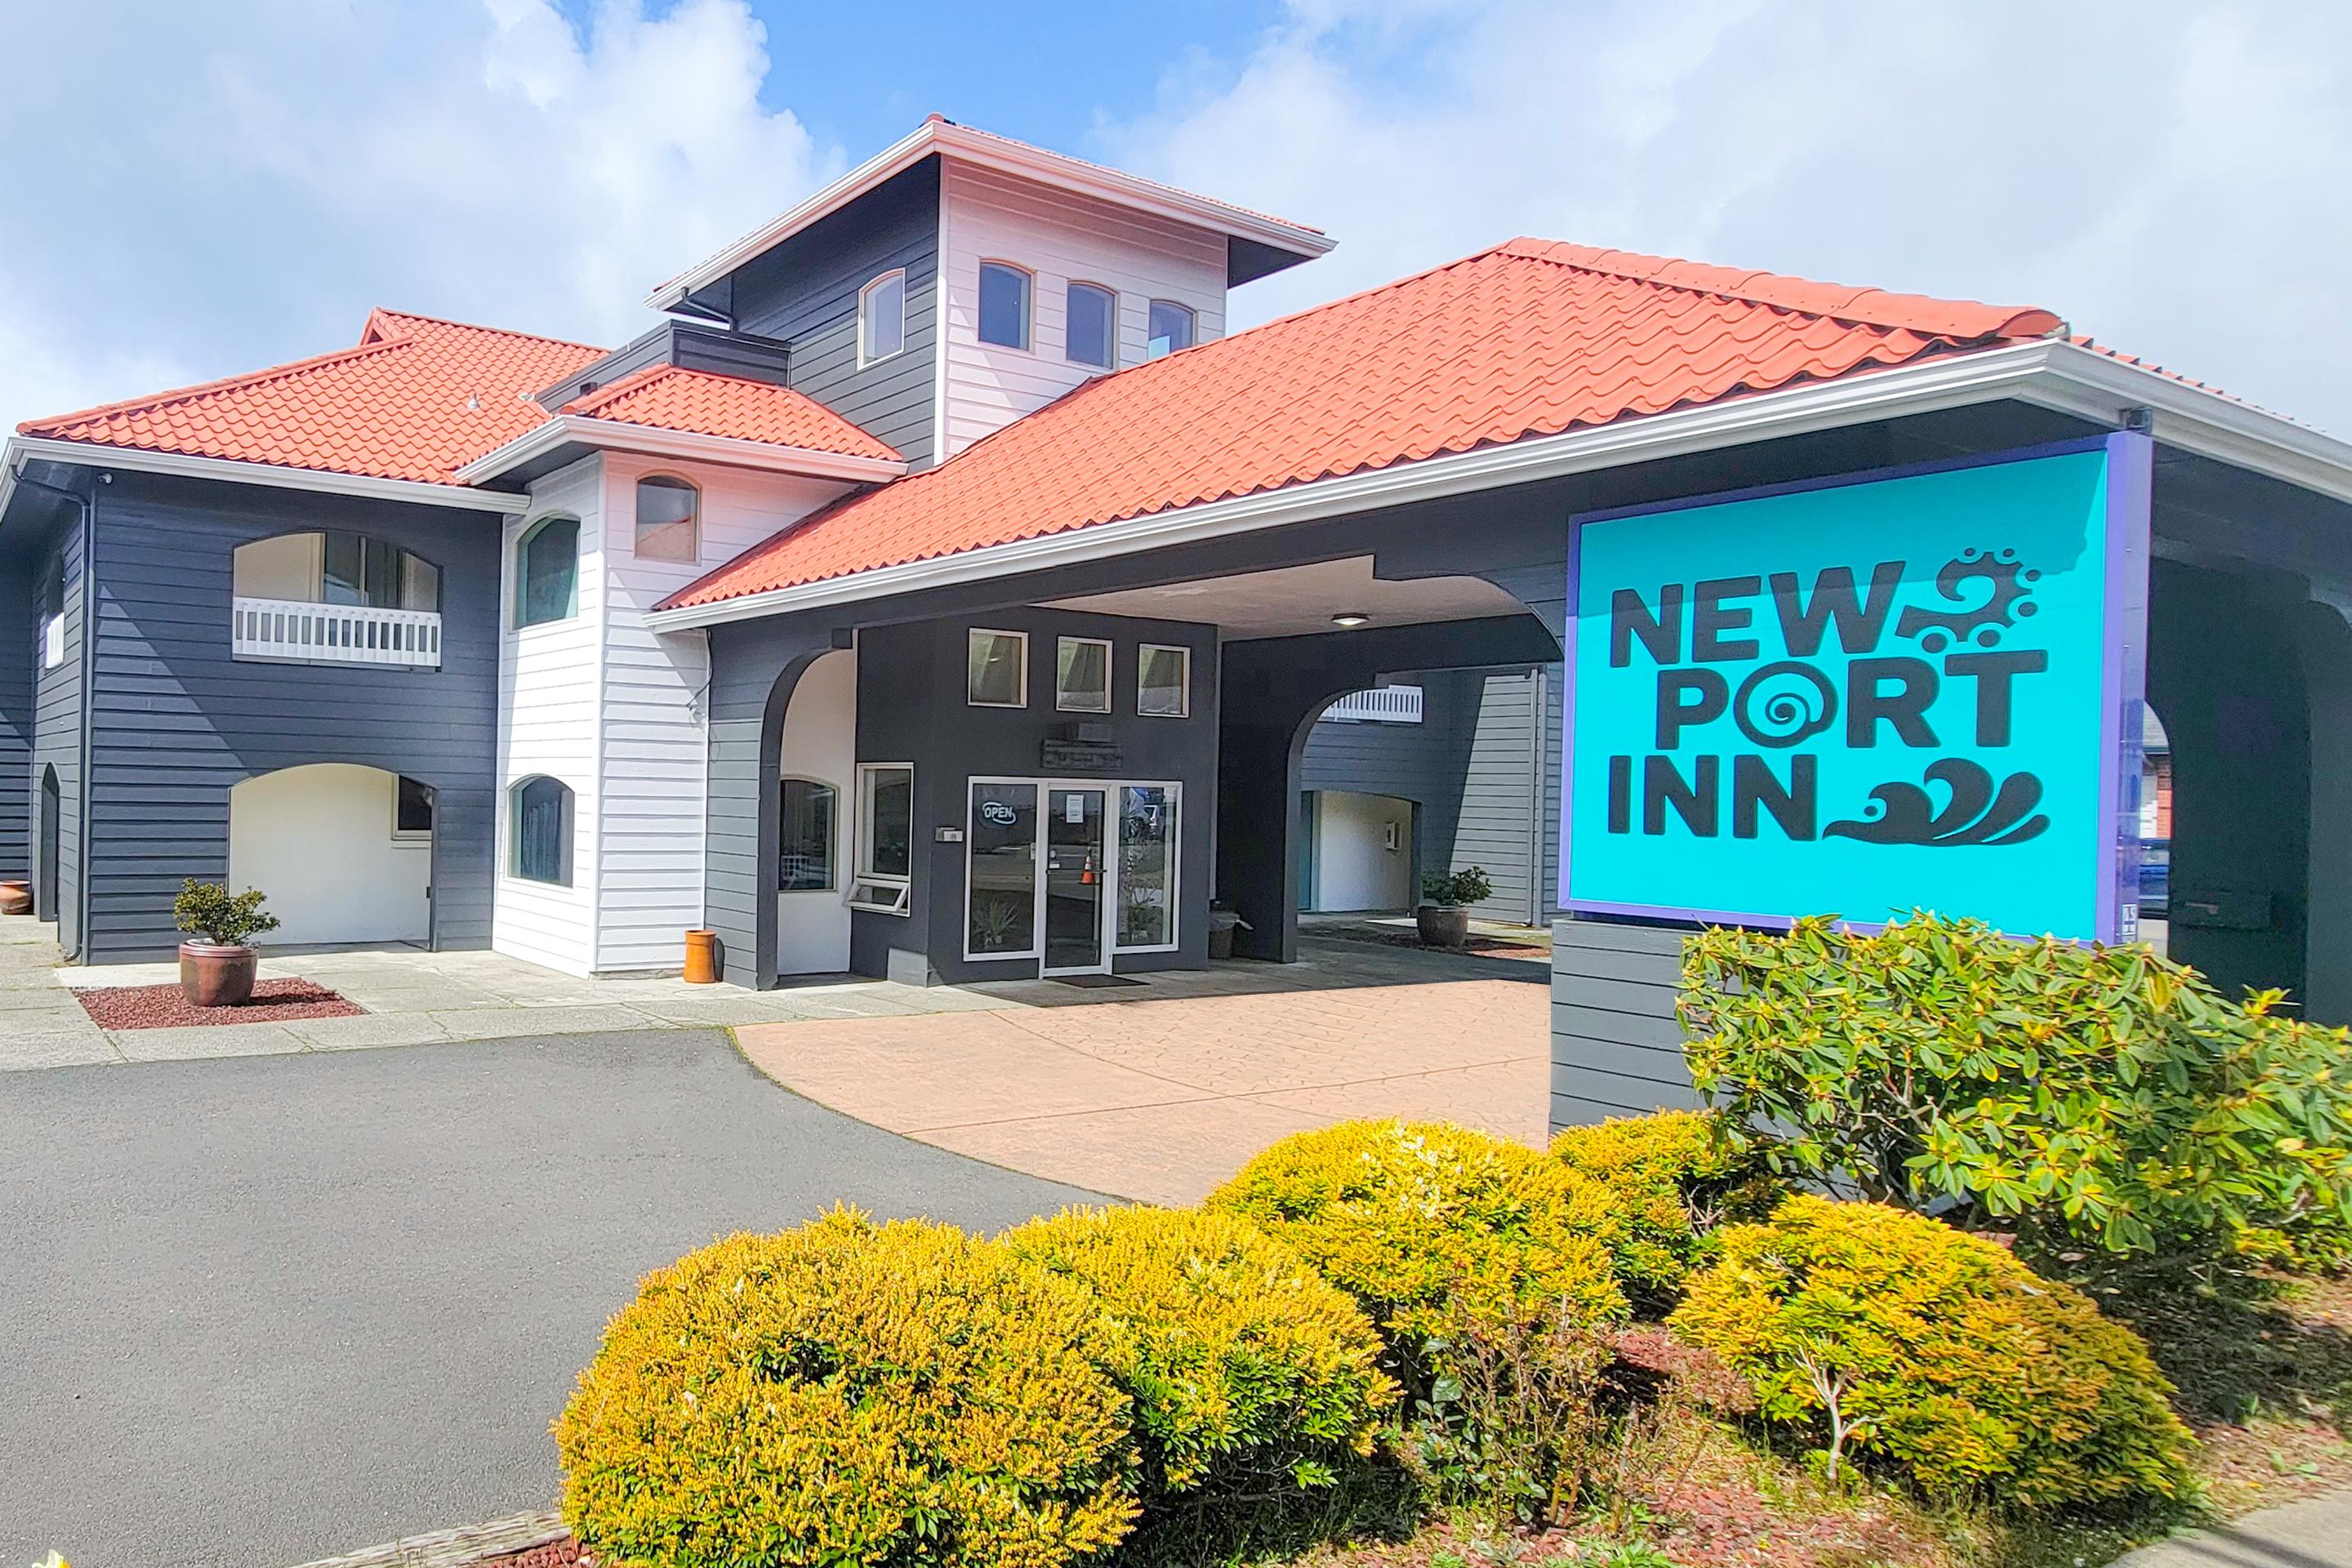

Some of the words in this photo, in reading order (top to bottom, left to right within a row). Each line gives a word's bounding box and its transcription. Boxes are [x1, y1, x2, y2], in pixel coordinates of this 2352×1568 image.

[1610, 560, 1906, 668] NEW
[1655, 650, 2048, 751] PORT
[984, 806, 1013, 818] OPEN
[1607, 754, 1818, 842] INN
